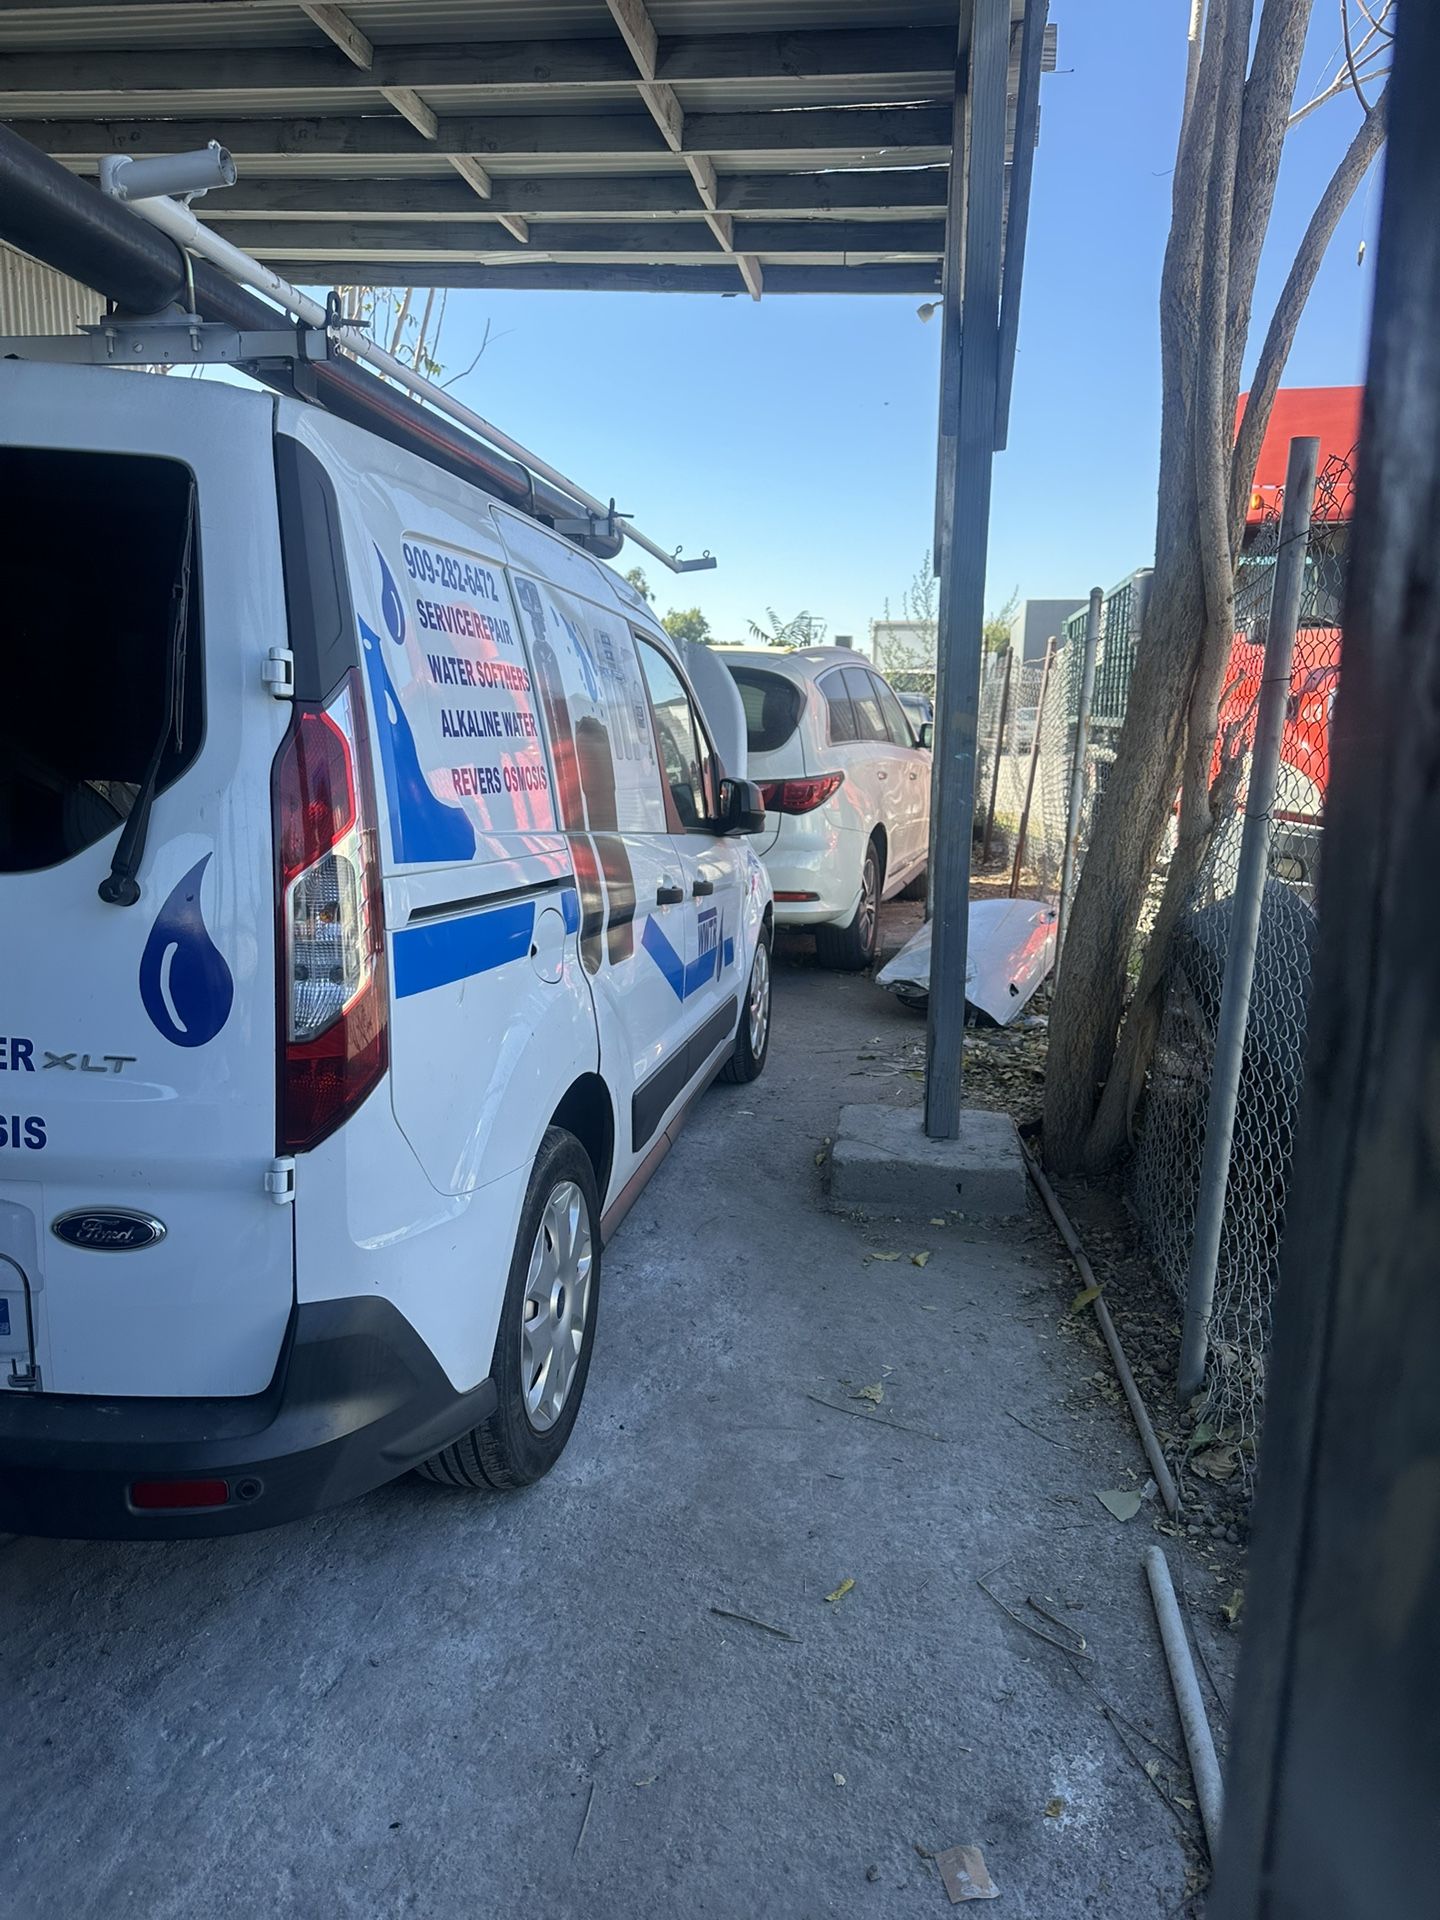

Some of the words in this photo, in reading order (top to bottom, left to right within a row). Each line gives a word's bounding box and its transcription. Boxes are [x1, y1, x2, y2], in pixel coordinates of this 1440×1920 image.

[403, 543, 499, 602] 909-282-6472
[416, 598, 514, 645] SERVICE/REPAIR
[427, 654, 476, 687] WATER
[441, 709, 503, 738] ALKALINE
[501, 711, 538, 737] WATER
[451, 766, 502, 796] REVERS
[503, 765, 548, 793] OSMOSIS
[42, 1051, 137, 1073] XLT
